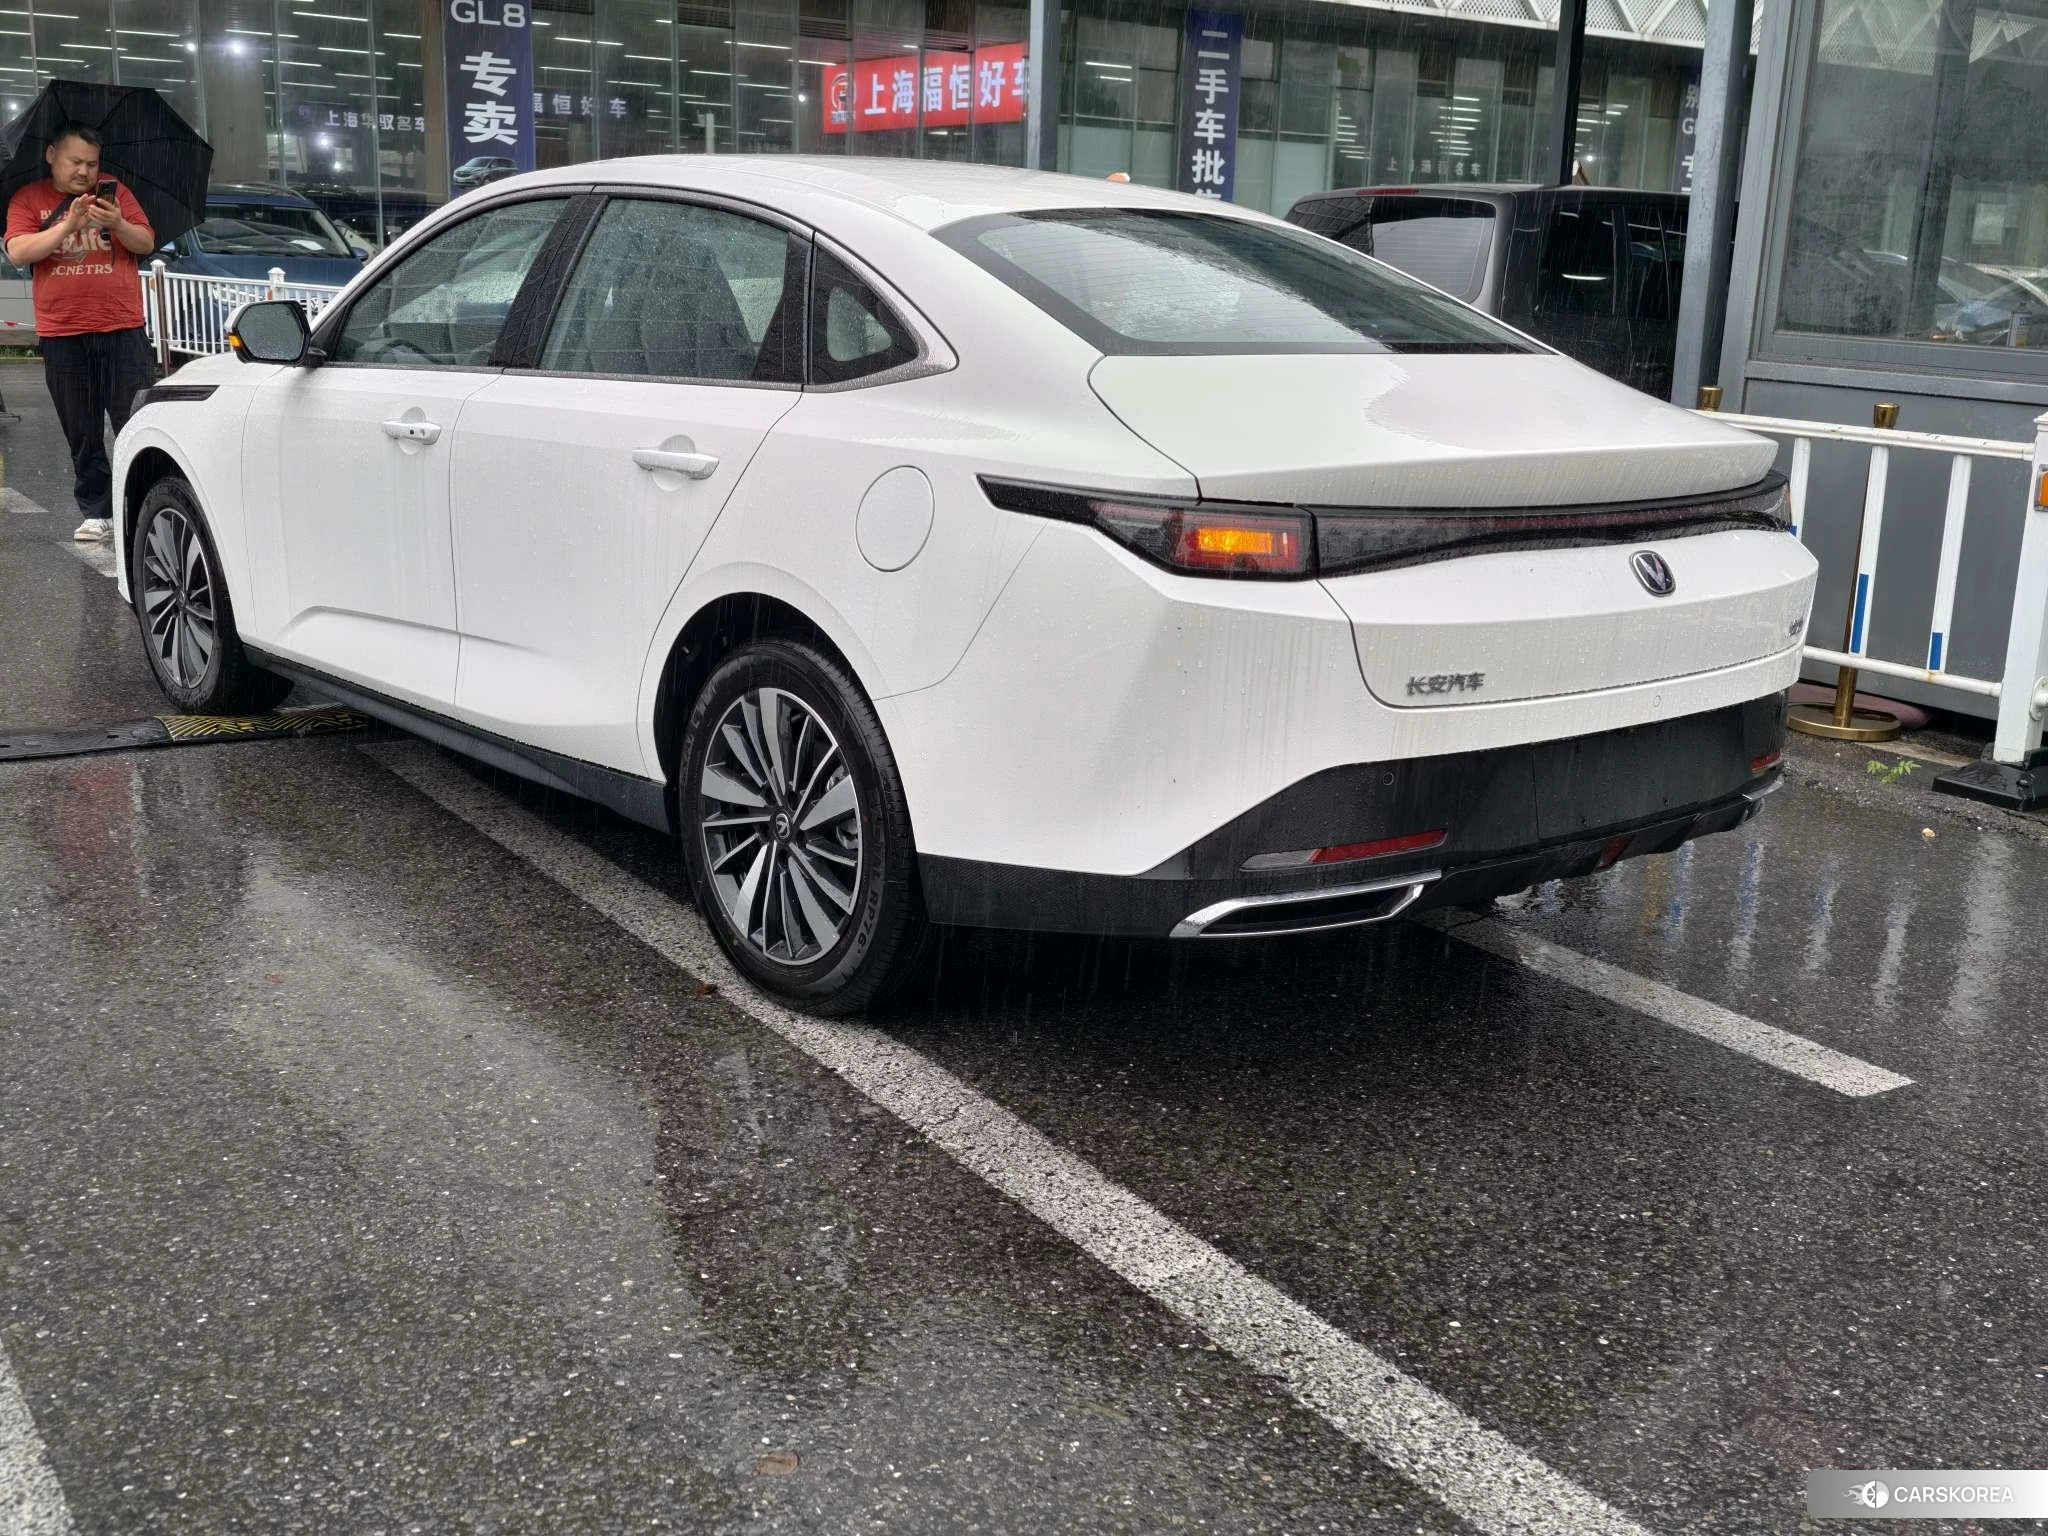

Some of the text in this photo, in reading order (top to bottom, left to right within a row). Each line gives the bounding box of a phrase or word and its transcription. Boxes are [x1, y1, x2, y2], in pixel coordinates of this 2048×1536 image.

[450, 0, 526, 28] GL8
[459, 51, 519, 146] 专卖
[1406, 672, 1486, 696] 长安汽车
